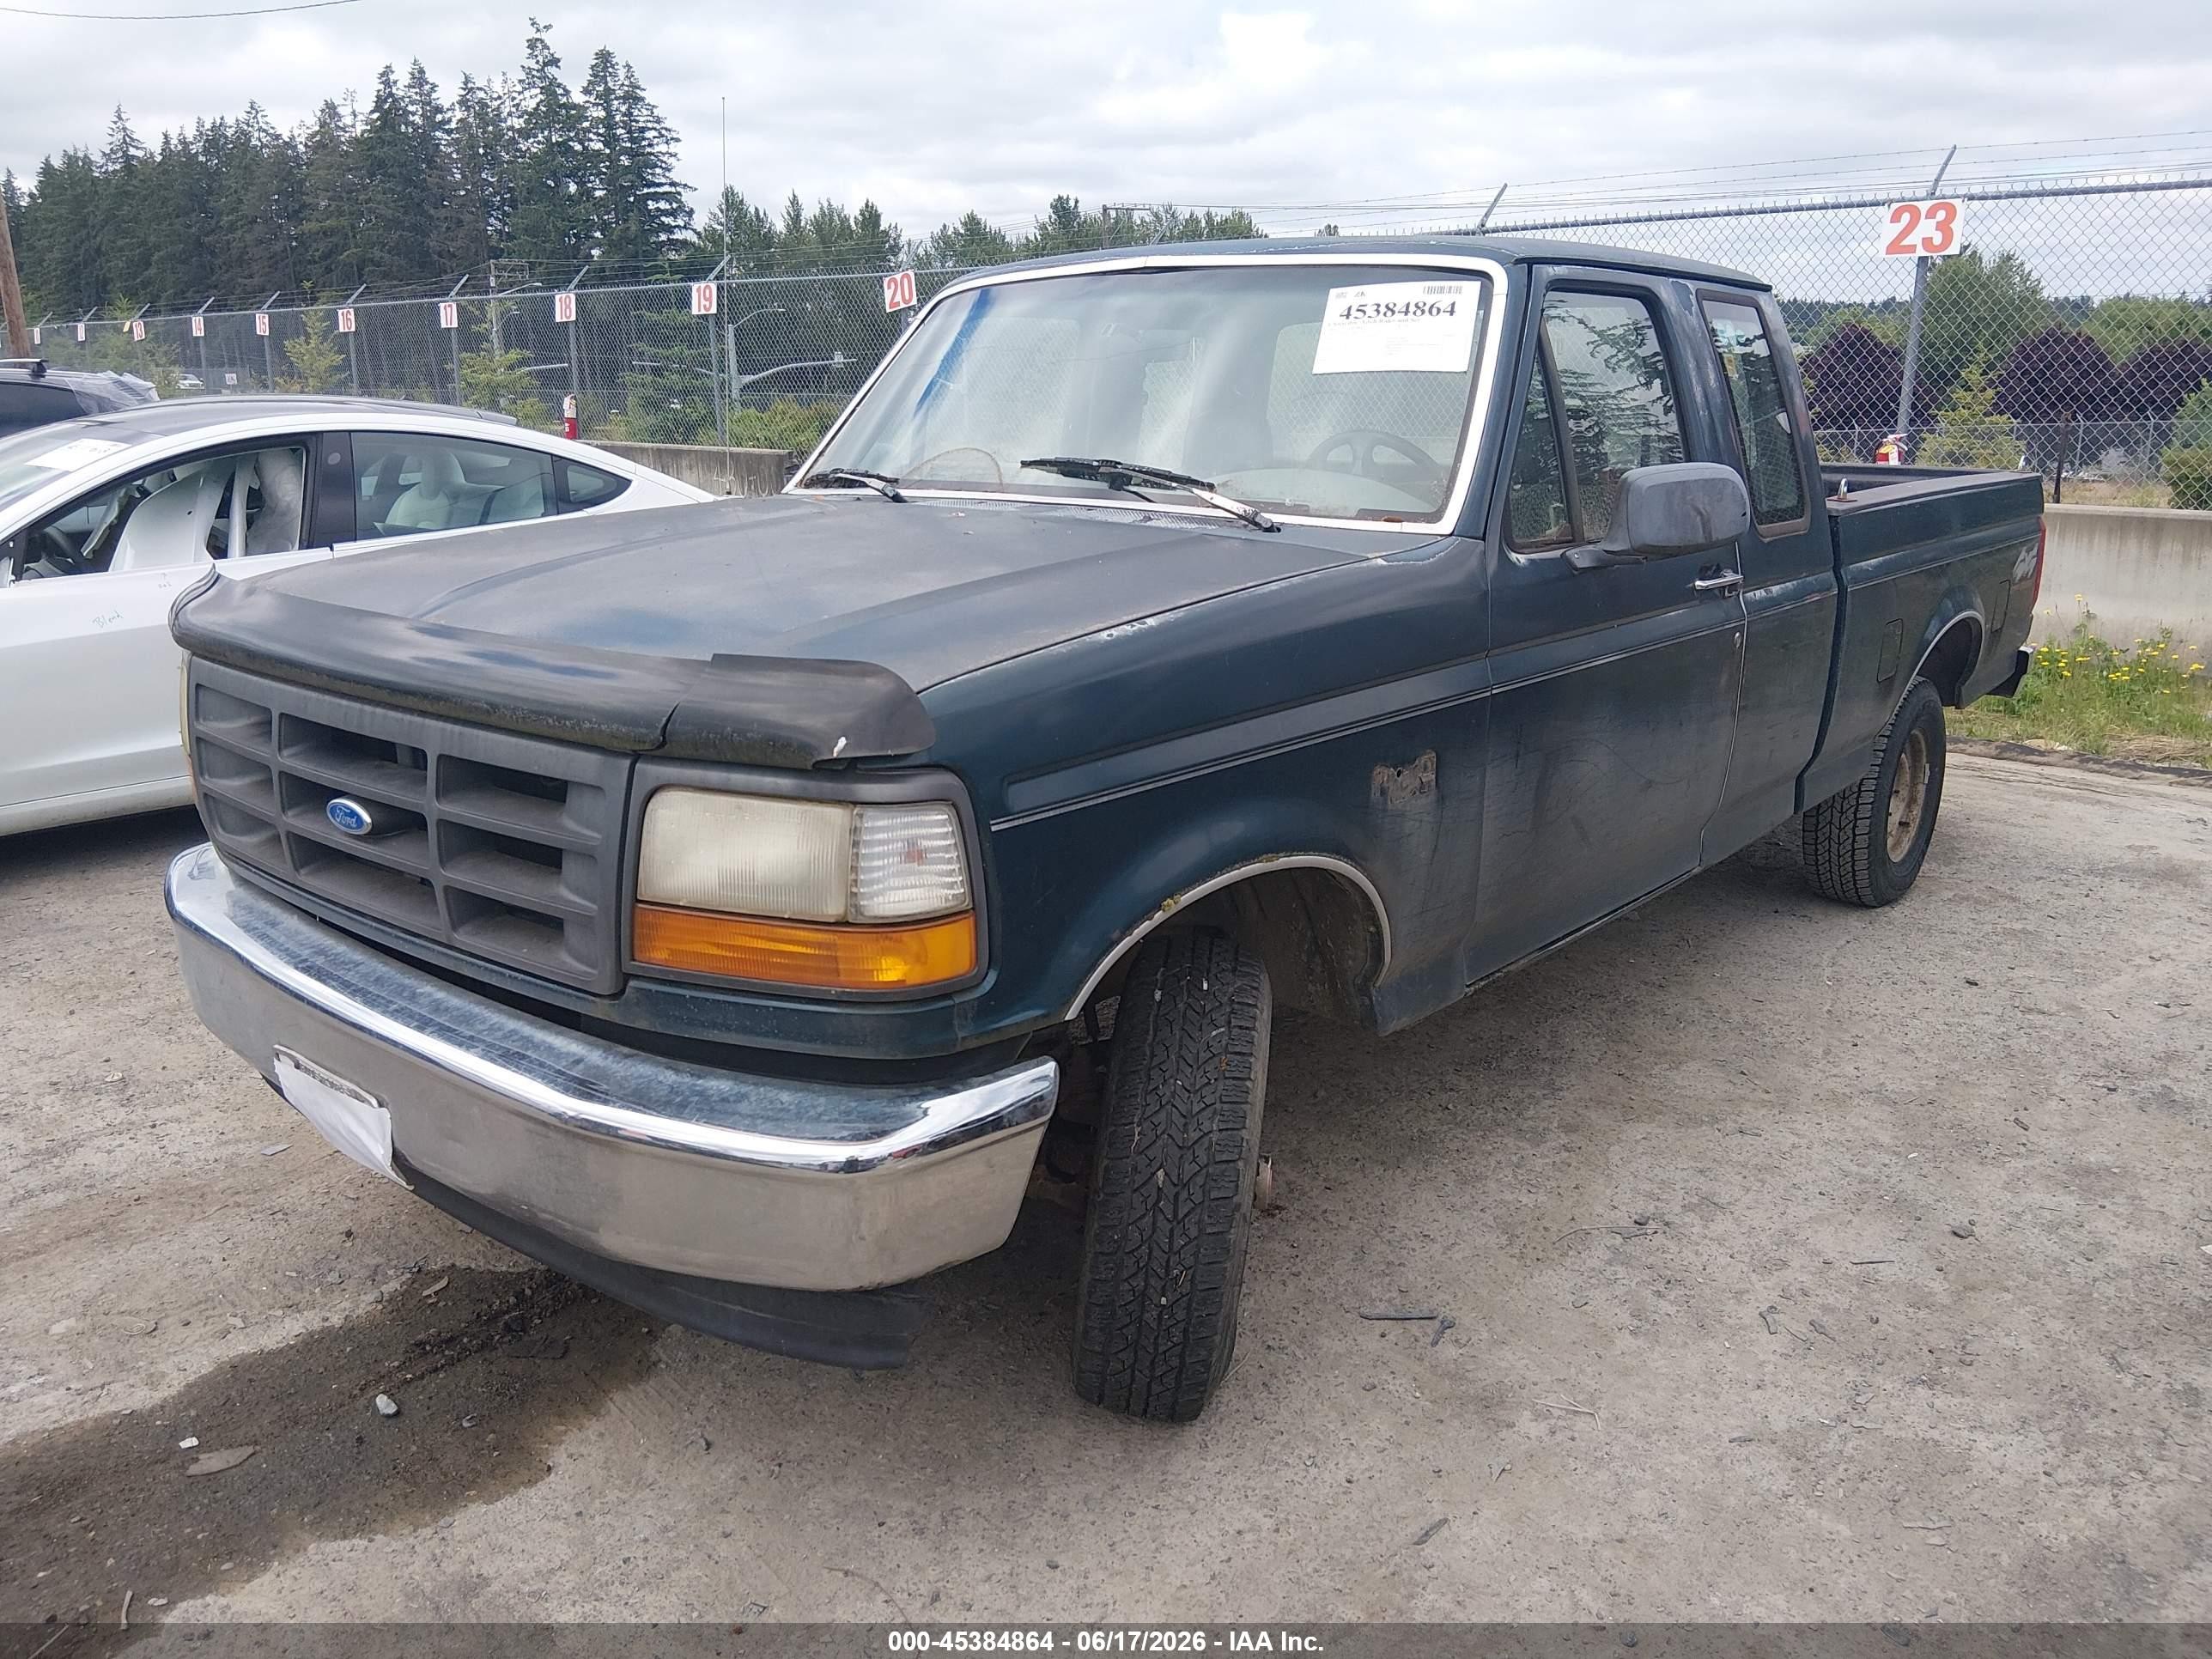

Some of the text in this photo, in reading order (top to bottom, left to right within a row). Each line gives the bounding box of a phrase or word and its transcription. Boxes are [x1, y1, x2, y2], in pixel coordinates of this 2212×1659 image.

[1886, 201, 1957, 255] 23
[696, 284, 714, 313] 19
[887, 273, 914, 309] 20
[444, 303, 453, 326] 17
[558, 295, 572, 320] 18
[1340, 301, 1456, 320] 45384864
[194, 317, 203, 336] 14
[258, 314, 267, 334] 15
[341, 310, 353, 331] 16
[335, 805, 358, 828] Ford
